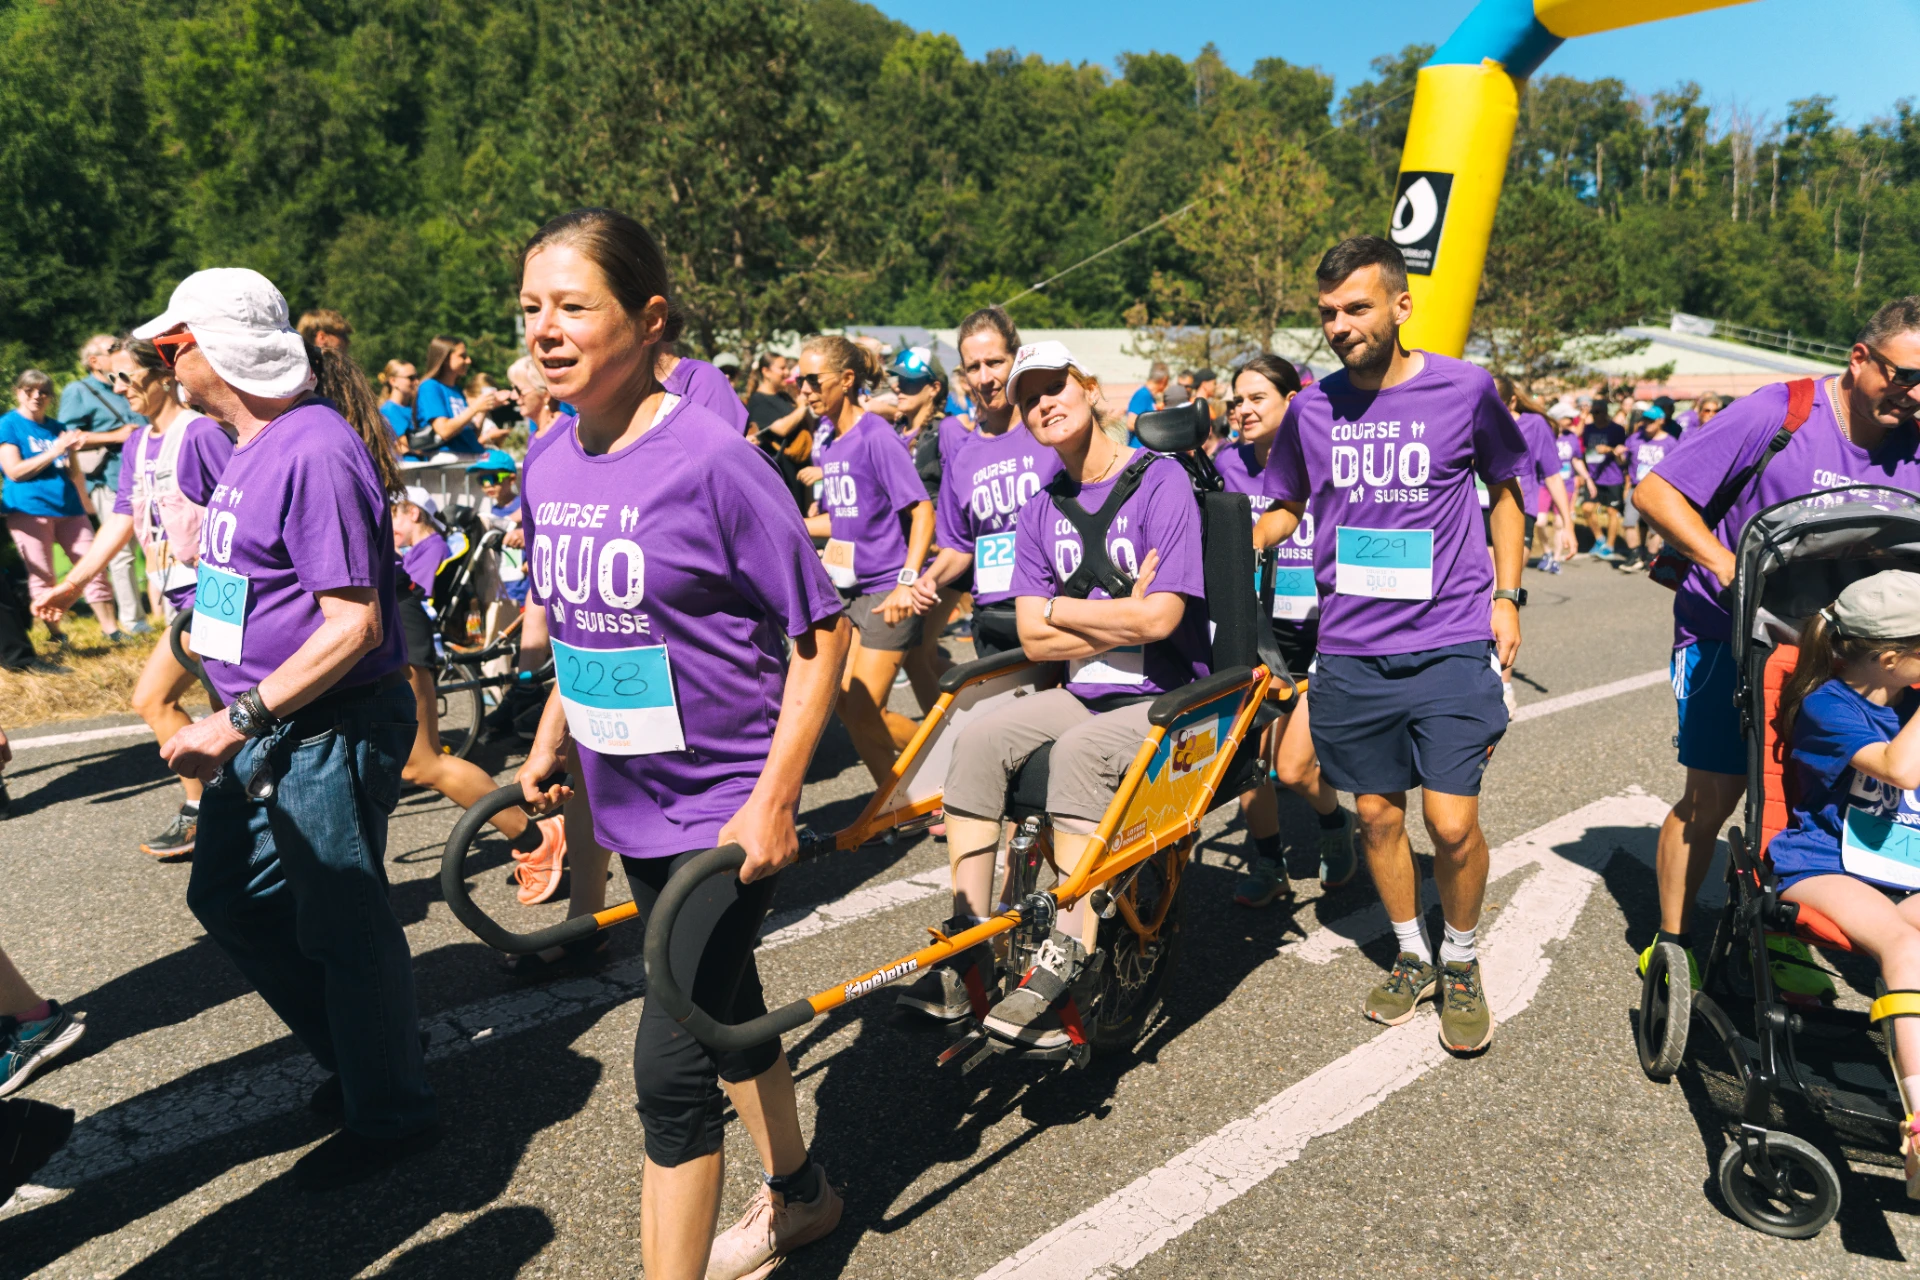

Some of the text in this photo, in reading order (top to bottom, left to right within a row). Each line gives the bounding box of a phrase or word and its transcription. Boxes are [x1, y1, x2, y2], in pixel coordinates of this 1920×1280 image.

[1331, 421, 1400, 441] COURSE
[973, 458, 1017, 486] COURSE
[1332, 442, 1431, 488] DUO
[972, 472, 1041, 521] DUO
[1374, 487, 1429, 503] SUISSE
[536, 502, 609, 529] COURSE
[983, 537, 1016, 567] 22
[1056, 537, 1140, 583] DO
[1355, 535, 1407, 559] 229
[532, 534, 645, 610] DUO
[1366, 574, 1398, 588] DUO
[575, 608, 650, 635] SUISSE
[568, 655, 648, 697] 228
[589, 718, 630, 740] DUO
[607, 739, 632, 747] SUISSE
[1869, 822, 1920, 863] 21
